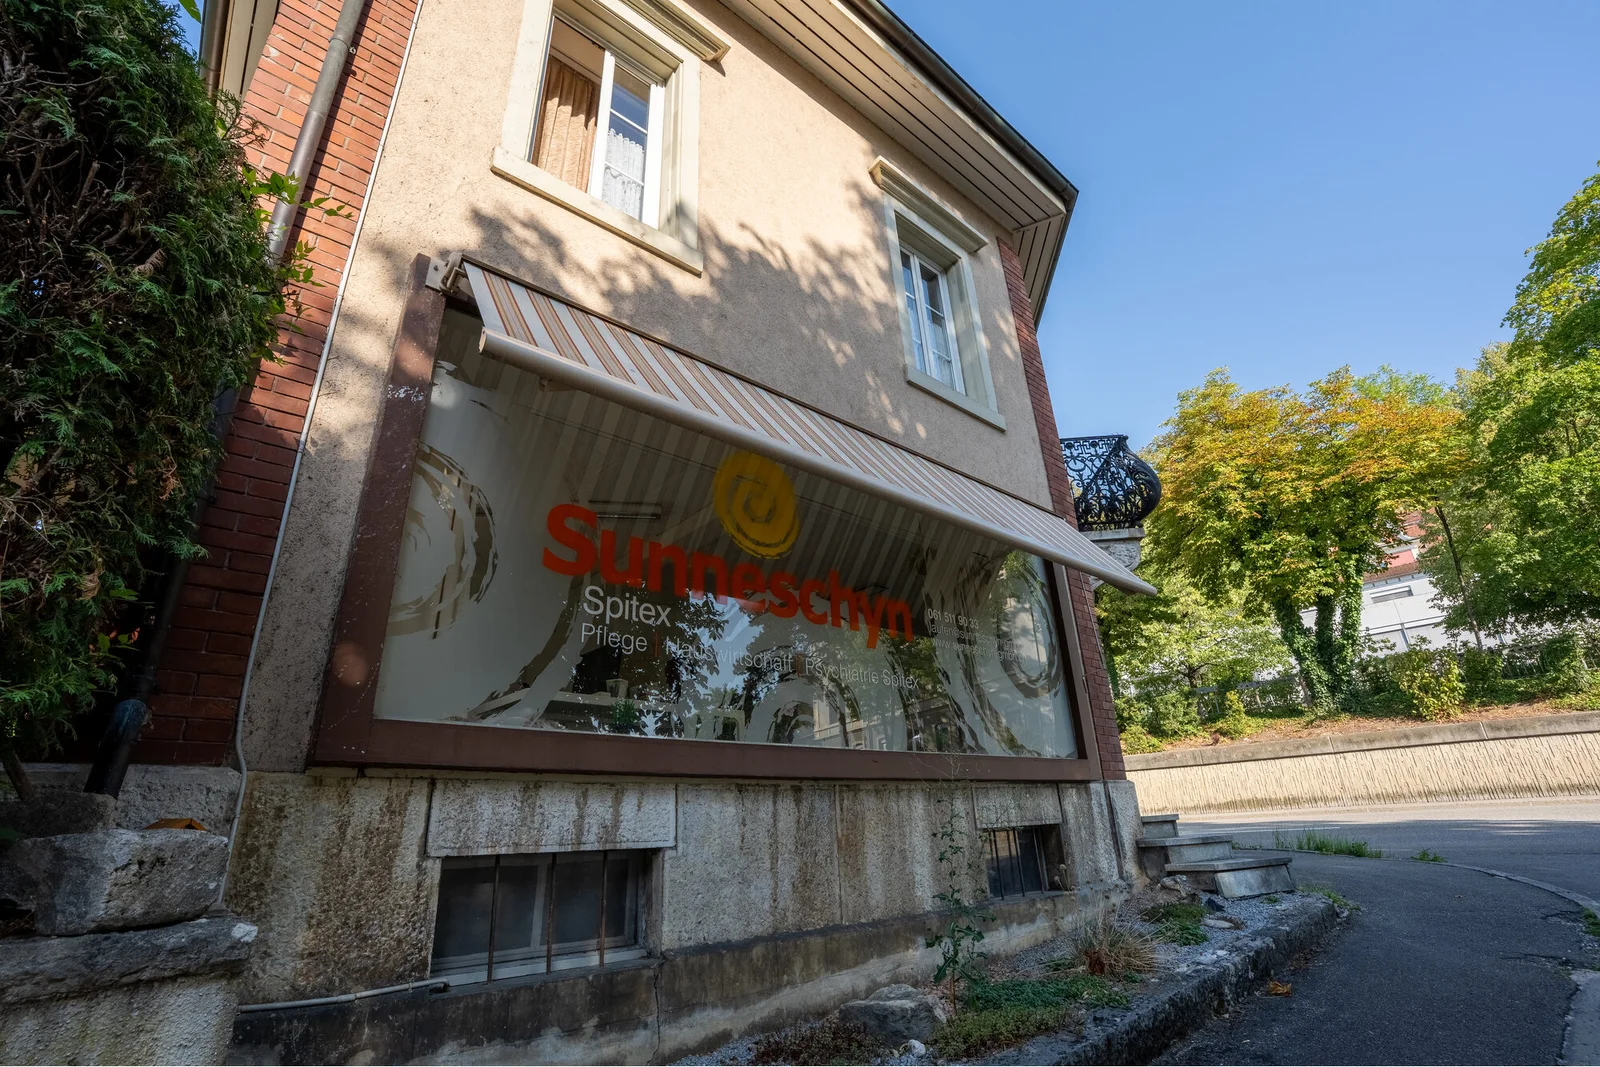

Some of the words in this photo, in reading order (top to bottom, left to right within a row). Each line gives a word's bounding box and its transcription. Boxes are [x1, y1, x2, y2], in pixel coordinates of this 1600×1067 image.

[542, 503, 913, 649] Sunneschyn
[583, 585, 672, 627] Spitex
[927, 608, 941, 620] 061
[944, 612, 957, 625] 511
[958, 615, 968, 627] 90
[969, 618, 980, 630] 33
[581, 622, 648, 655] Pflege
[665, 636, 793, 673] Hauswirtschaft
